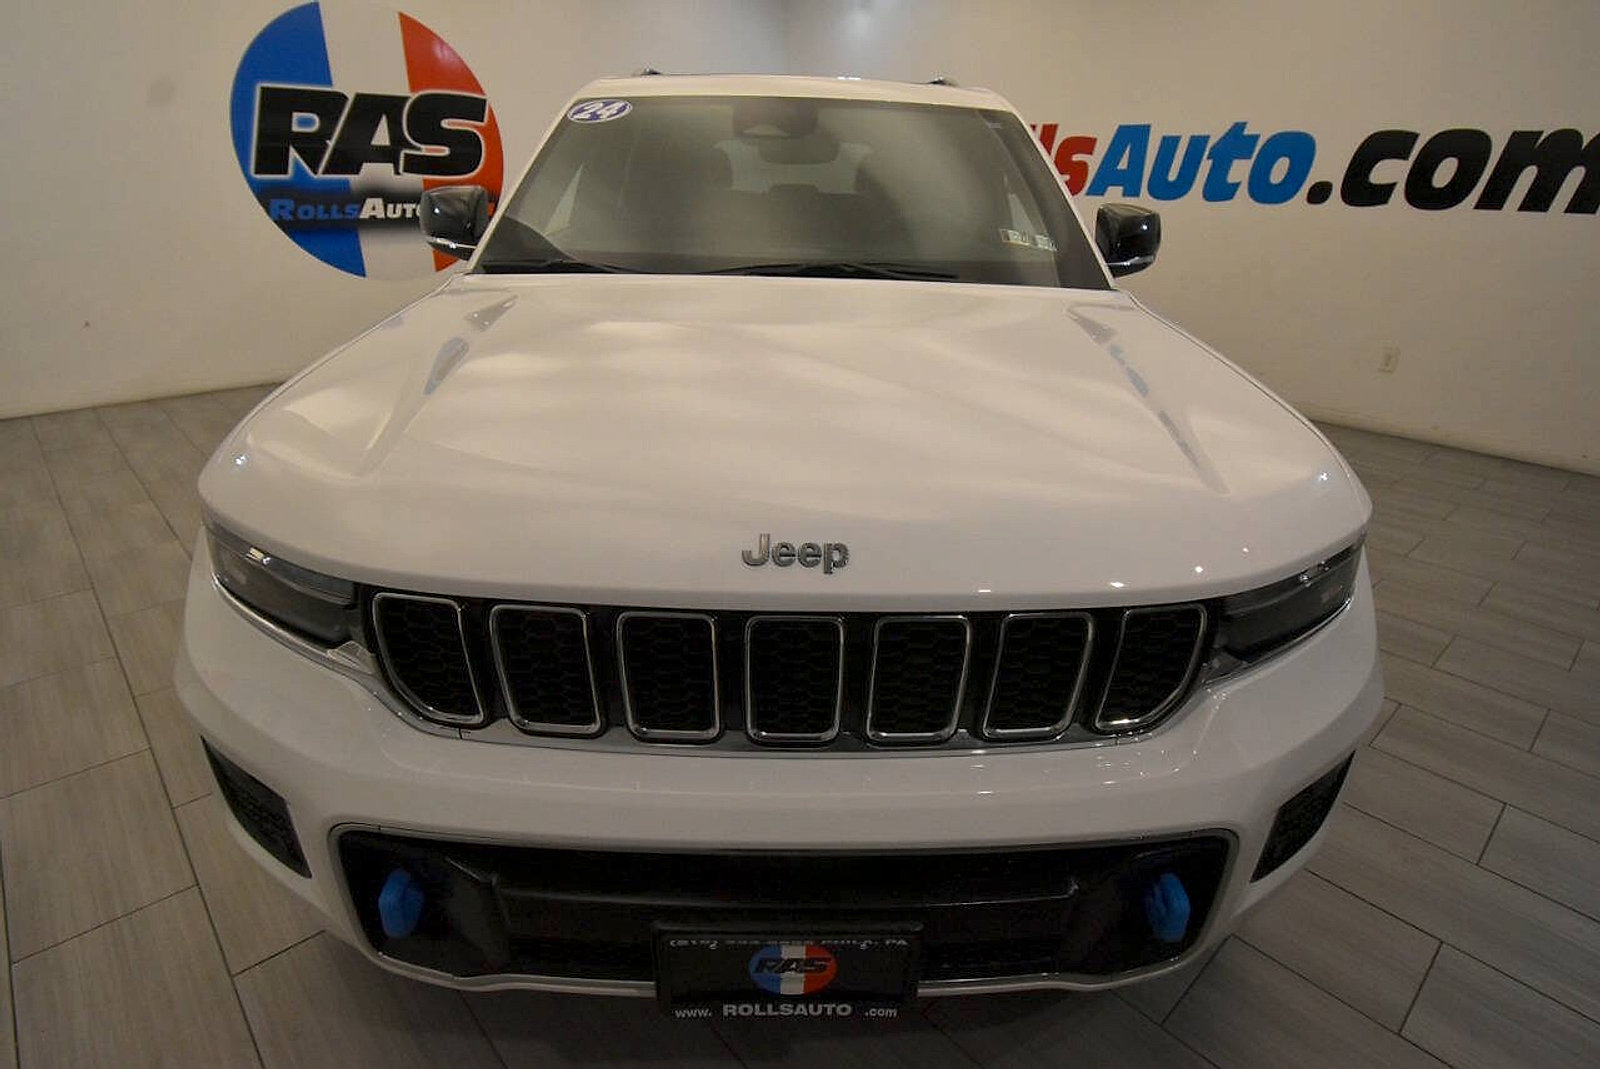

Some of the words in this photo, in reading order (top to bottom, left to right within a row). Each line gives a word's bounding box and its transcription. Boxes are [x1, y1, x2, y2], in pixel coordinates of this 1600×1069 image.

[572, 101, 625, 120] 24
[253, 84, 488, 177] RAS
[1031, 121, 1600, 214] sAuto.com
[741, 533, 850, 575] Jeep
[752, 957, 833, 974] RAS
[674, 1007, 712, 1018] www.
[722, 1003, 852, 1017] ROLLSAUTO
[864, 1007, 898, 1018] .com
